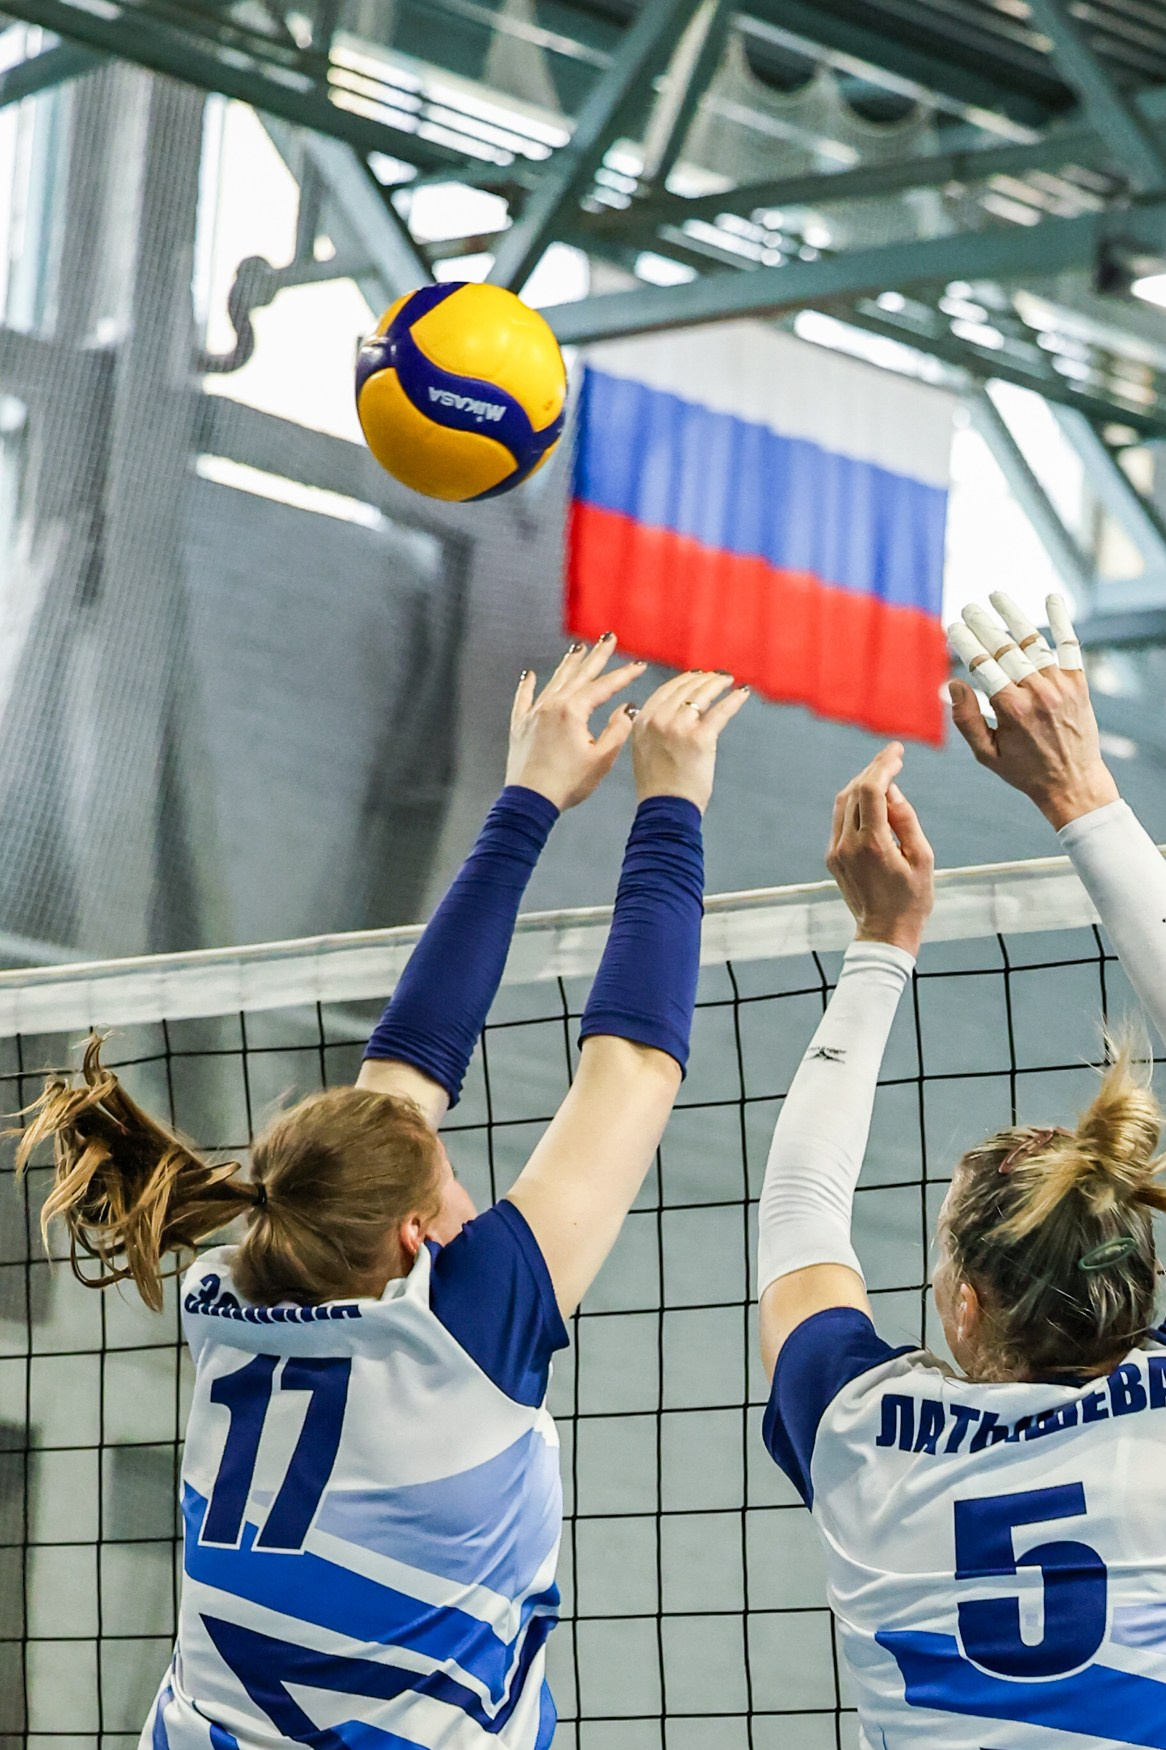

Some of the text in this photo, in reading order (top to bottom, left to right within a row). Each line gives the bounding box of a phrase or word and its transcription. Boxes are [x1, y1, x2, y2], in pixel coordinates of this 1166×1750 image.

[428, 386, 507, 422] MIKASA
[201, 1353, 353, 1554] 17
[954, 1481, 1108, 1678] 5
